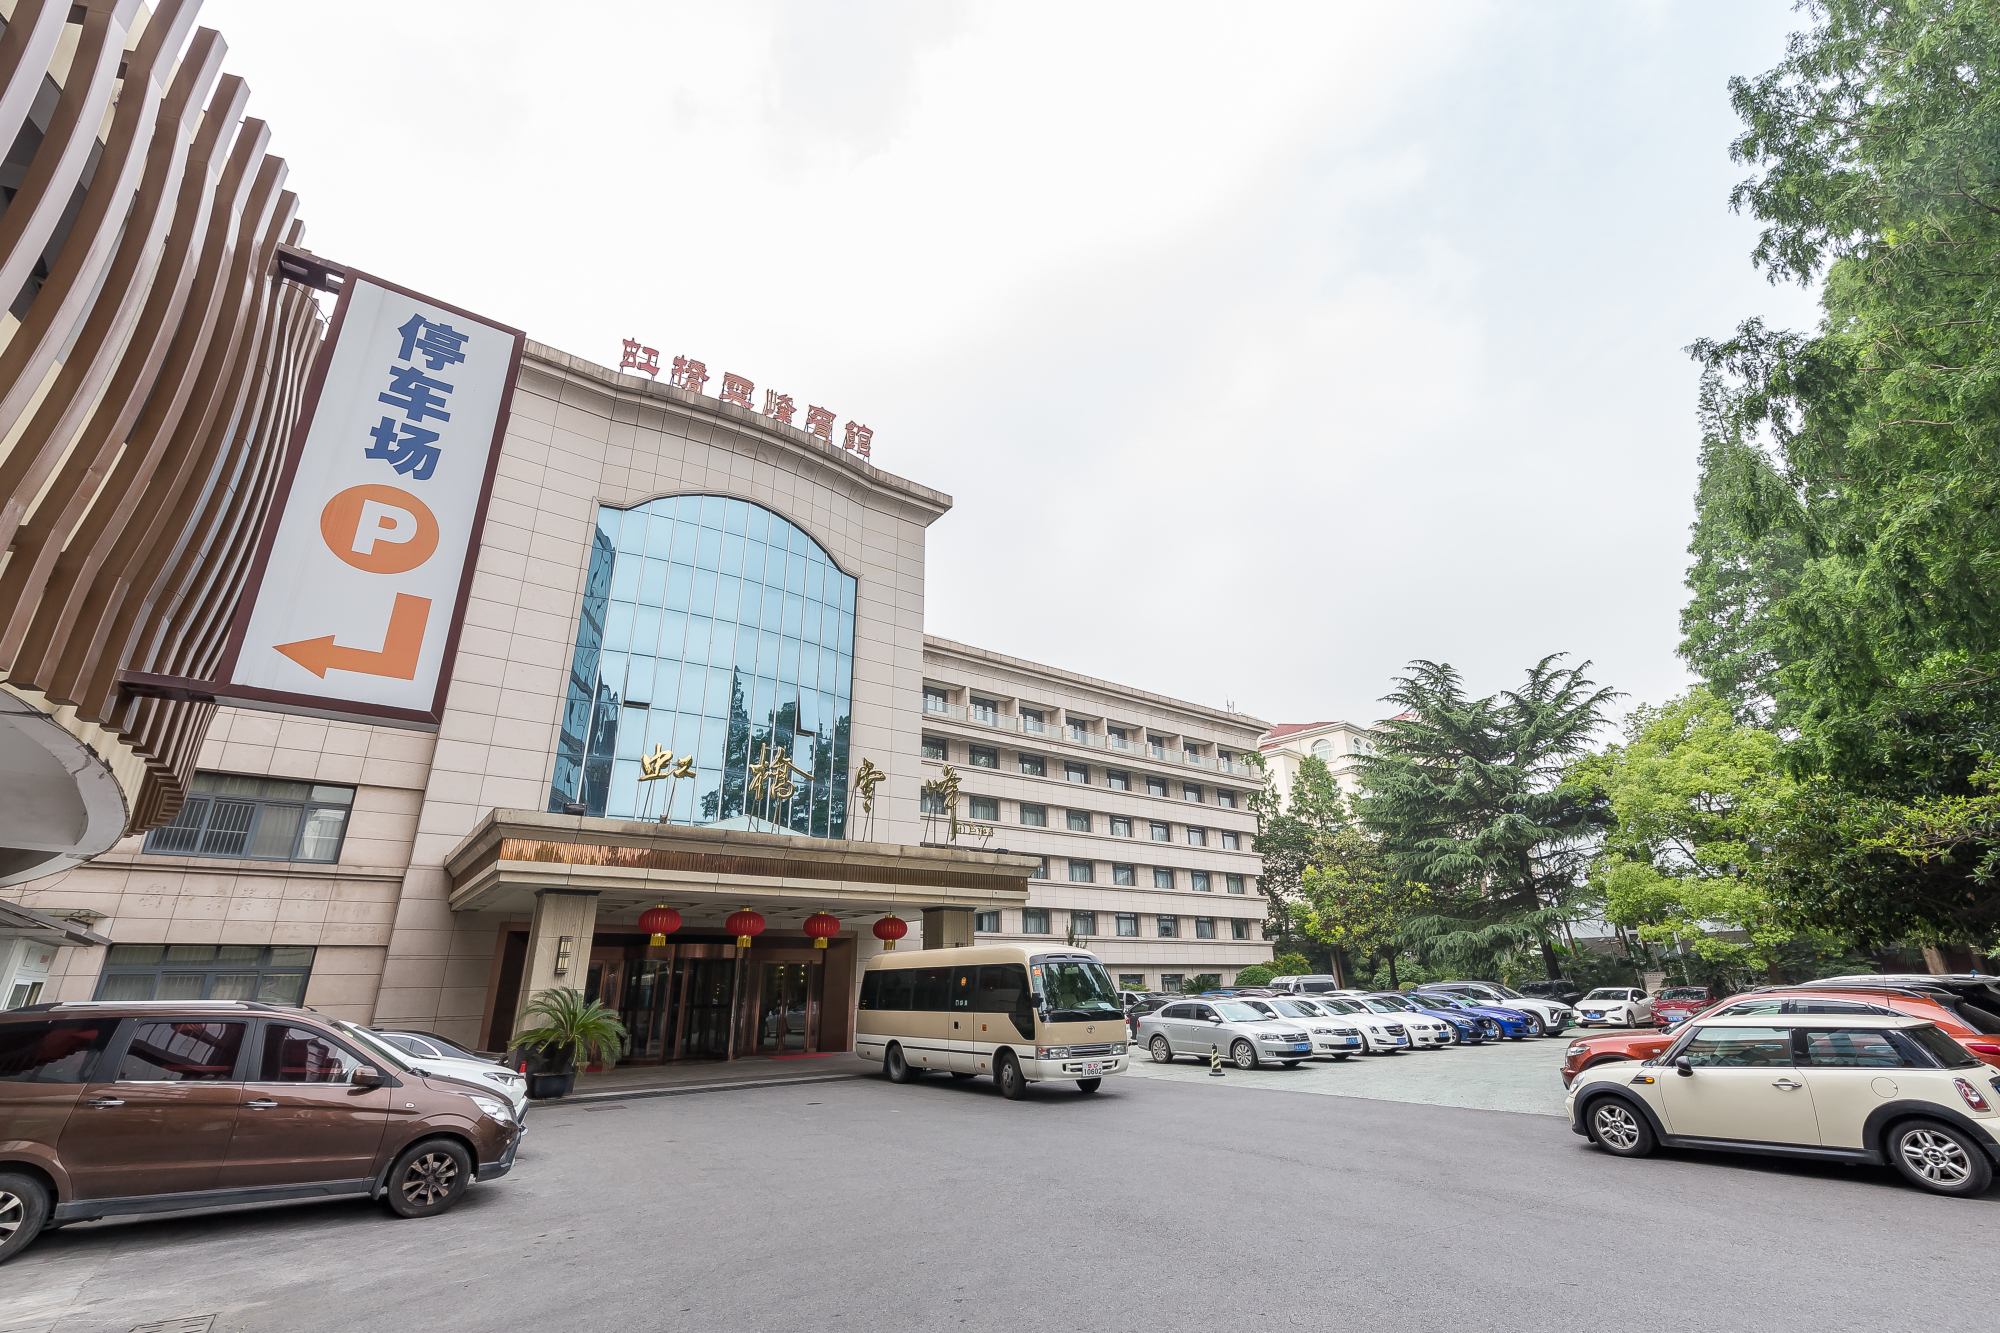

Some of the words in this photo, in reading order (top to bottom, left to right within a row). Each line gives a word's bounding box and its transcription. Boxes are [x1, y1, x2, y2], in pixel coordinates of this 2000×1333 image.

[364, 313, 470, 481] 停车场
[351, 498, 418, 556] P
